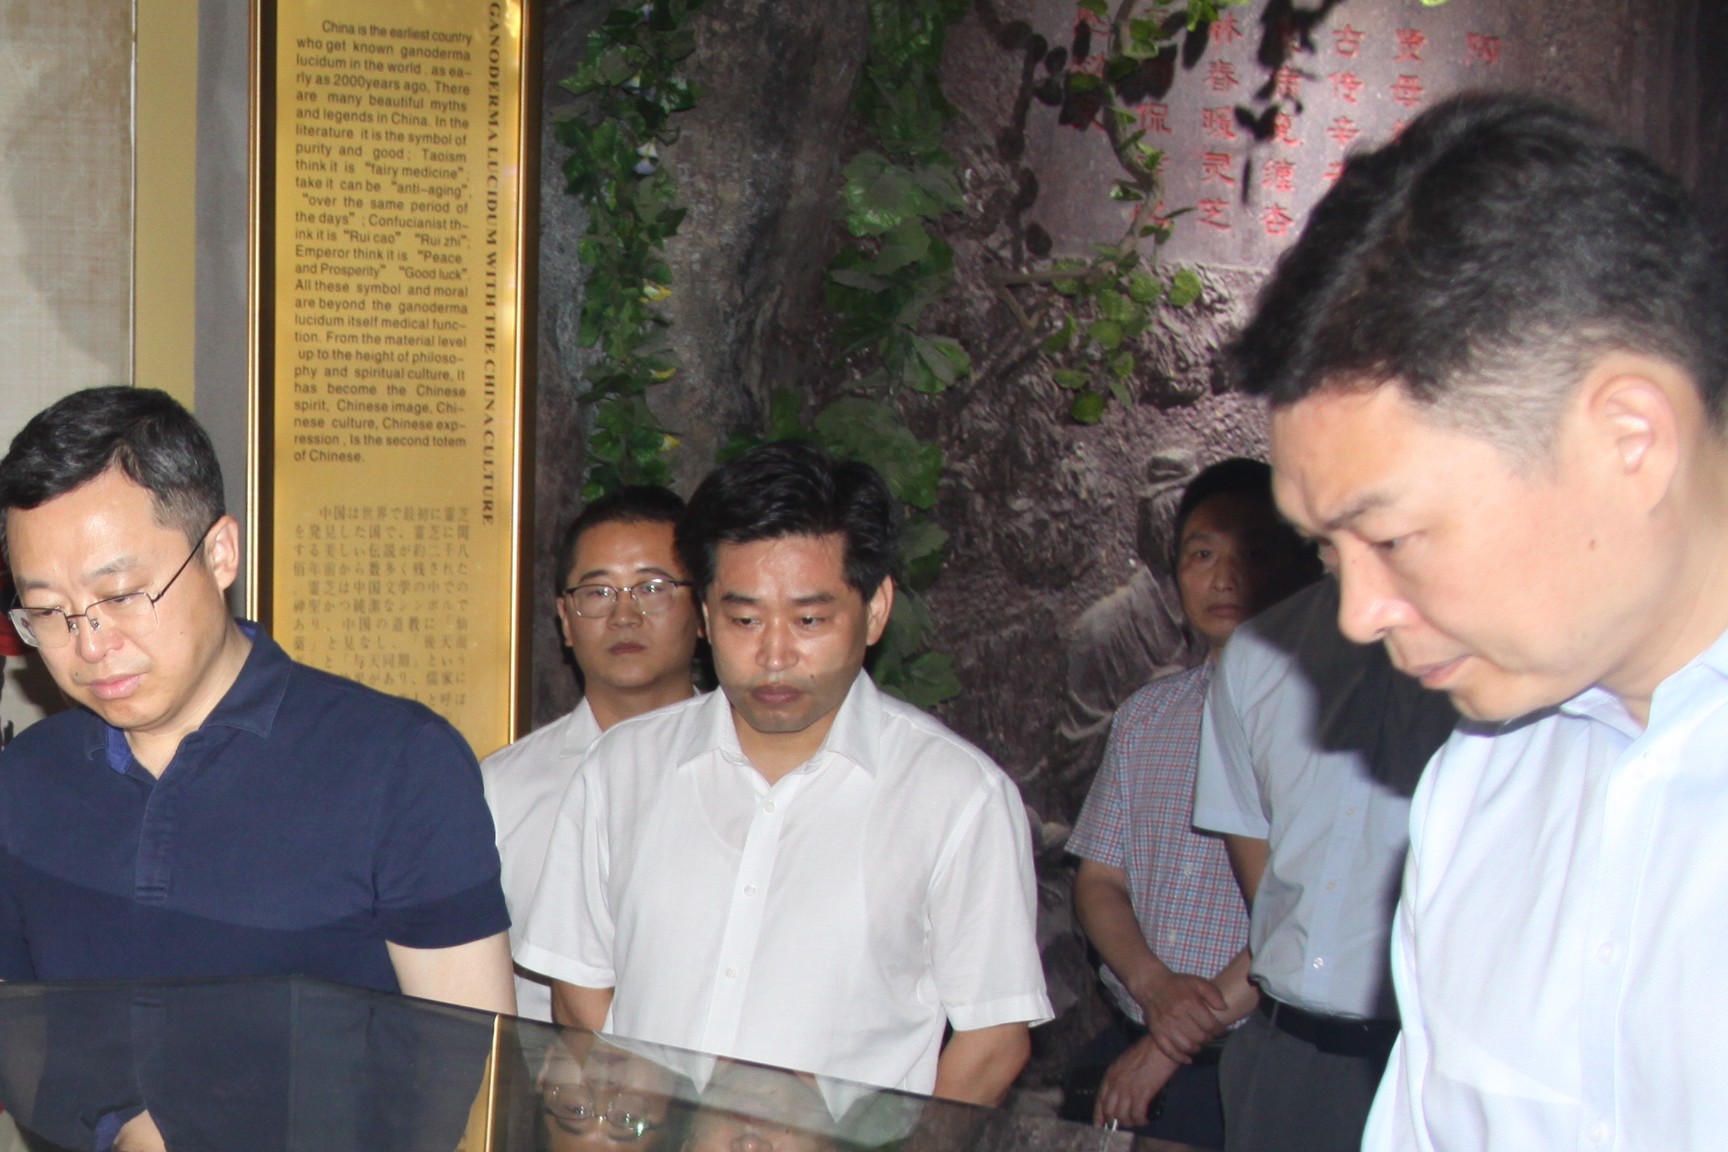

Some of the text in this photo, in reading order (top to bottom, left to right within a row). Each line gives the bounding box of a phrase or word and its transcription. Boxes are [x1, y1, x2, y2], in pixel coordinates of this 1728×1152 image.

[322, 19, 472, 47] China is the earliest country
[296, 36, 470, 63] who get known ganoderma
[296, 53, 345, 68] lucidum
[350, 60, 360, 68] in
[364, 59, 383, 71] the
[432, 66, 445, 76] as
[296, 71, 311, 86] rly
[315, 74, 329, 84] as
[296, 90, 466, 114] are many beautiful myths
[296, 106, 319, 119] and
[323, 108, 373, 125] legends
[377, 113, 387, 122] in
[435, 116, 446, 126] In
[450, 116, 468, 129] the
[296, 123, 466, 147] literature it is the symbol of
[295, 142, 331, 157] purity
[339, 144, 362, 156] and
[422, 148, 466, 162] Taoism
[296, 158, 325, 171] think
[330, 161, 337, 172] it
[344, 161, 354, 173] is
[365, 161, 397, 178] "fairy
[295, 176, 321, 189] take
[326, 178, 332, 188] it
[340, 180, 362, 190] can
[366, 180, 380, 191] be
[302, 192, 467, 214] "over the same period of
[295, 210, 314, 223] the
[368, 213, 446, 229] Confucianist
[295, 228, 312, 239] ink
[316, 229, 323, 239] it
[327, 231, 336, 241] is
[295, 244, 462, 264] Emperor think it is "Peace
[295, 262, 316, 274] and
[399, 265, 435, 279] "Good
[481, 2, 500, 527] GANODERMA LUCIDUM WITH THE CHINA CULTURE
[295, 278, 468, 297] All these symbol and moral
[295, 297, 467, 316] are beyond the ganoderma
[295, 313, 344, 326] lucidum
[348, 315, 377, 327] itself
[381, 317, 428, 329] medical
[326, 331, 357, 343] From
[362, 333, 380, 344] the
[385, 335, 434, 345] material
[438, 336, 466, 347] level
[298, 350, 313, 361] up
[317, 349, 328, 359] to
[332, 349, 351, 360] the
[355, 350, 393, 364] height
[397, 351, 408, 361] of
[294, 364, 316, 379] phy
[324, 365, 347, 377] and
[354, 366, 404, 380] spiritual
[457, 369, 465, 380] It
[294, 381, 466, 397] has become the Chinese
[337, 399, 388, 412] Chinese
[294, 418, 324, 427] nese
[382, 417, 432, 429] Chinese
[350, 434, 360, 445] Is
[364, 434, 382, 445] the
[386, 435, 429, 446] second
[432, 436, 466, 447] totem
[293, 449, 364, 462] of Chinese.
